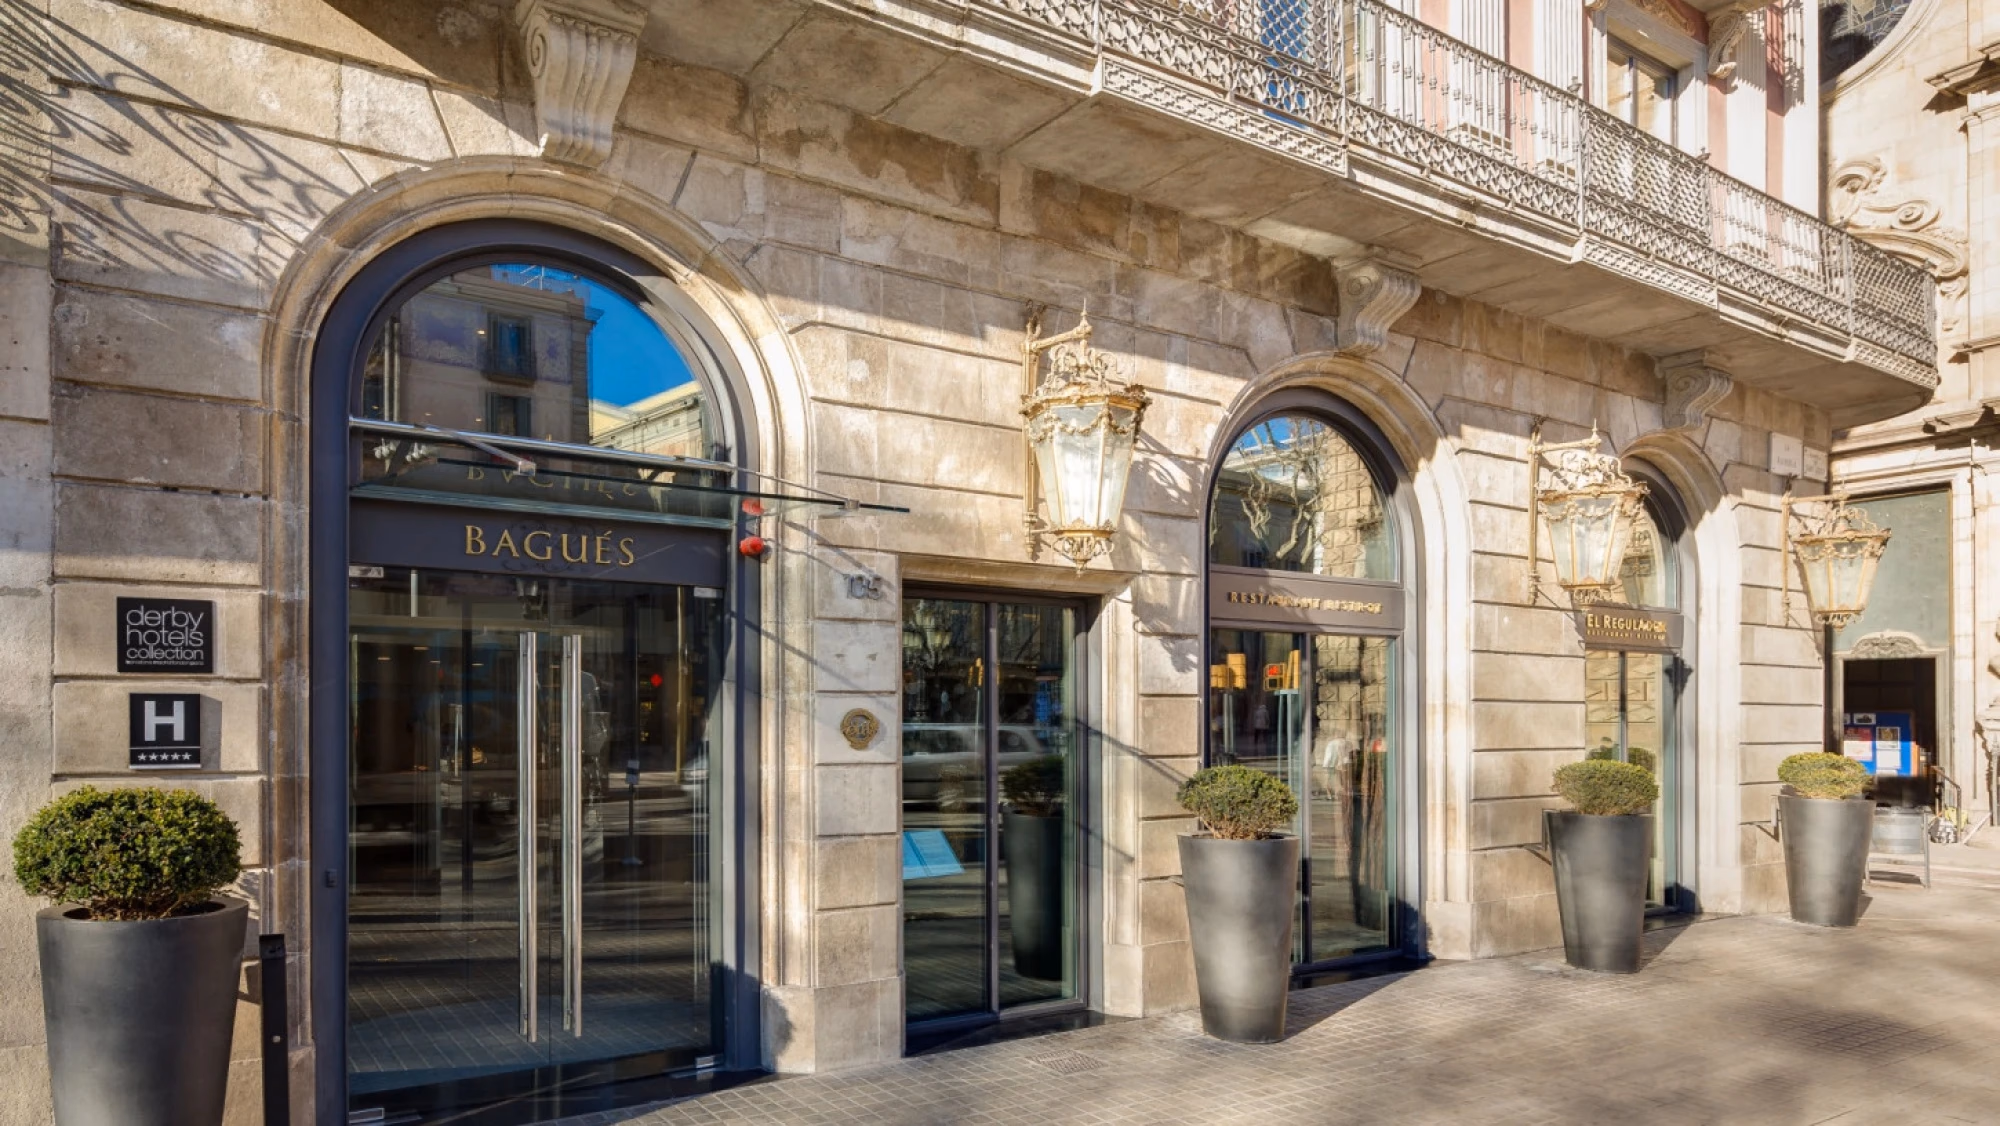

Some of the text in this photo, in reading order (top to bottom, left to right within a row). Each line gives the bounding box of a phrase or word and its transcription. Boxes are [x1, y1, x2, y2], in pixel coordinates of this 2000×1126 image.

[465, 525, 635, 566] BAGUÉS
[126, 605, 204, 629] derby
[126, 625, 204, 647] hotels
[126, 645, 204, 660] collection
[144, 700, 185, 742] H
